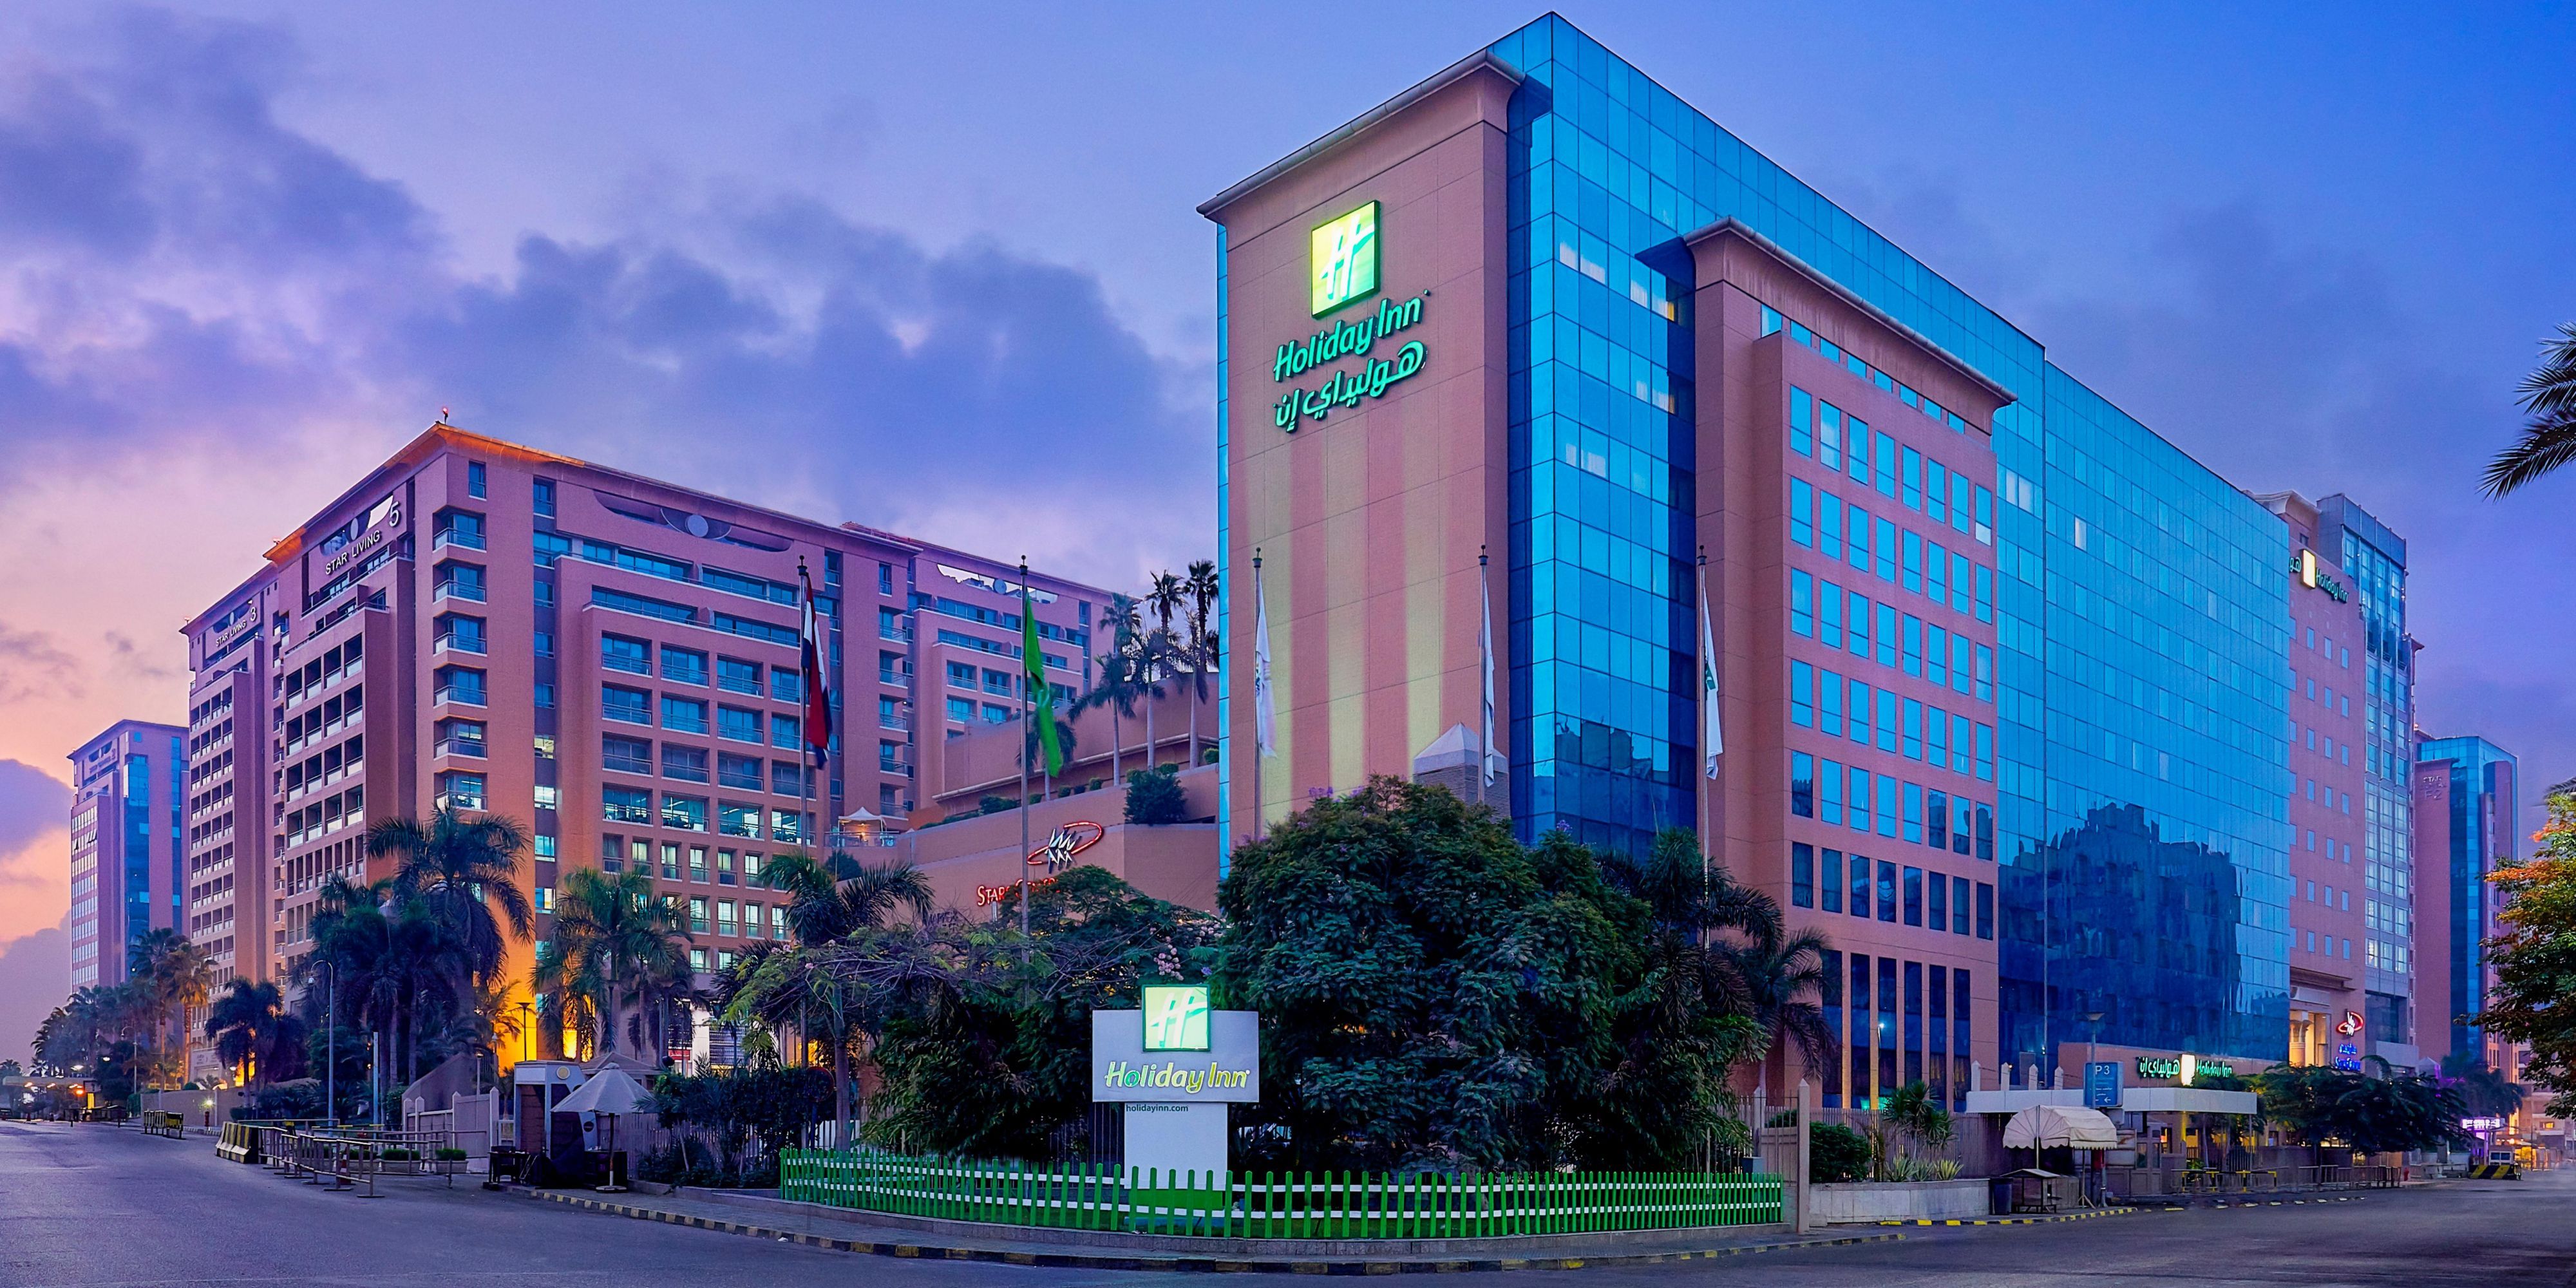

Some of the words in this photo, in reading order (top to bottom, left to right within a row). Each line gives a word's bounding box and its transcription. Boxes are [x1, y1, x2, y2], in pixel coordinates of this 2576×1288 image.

[1273, 319, 1377, 382] Holiday
[1377, 298, 1423, 338] Inn
[1302, 341, 1427, 420] هوليداي
[1274, 388, 1303, 433] إن
[389, 501, 399, 527] 5
[325, 552, 348, 575] STAR
[352, 530, 381, 558] LIVING
[2316, 568, 2338, 600] Holiday
[2339, 582, 2349, 602] Inn
[250, 607, 256, 622] 3
[216, 632, 229, 647] STAR
[230, 620, 247, 637] LIVING
[1104, 1061, 1204, 1094] Holiday
[1208, 1062, 1247, 1088] Inn
[2148, 1058, 2180, 1079] هوليداي
[2222, 1061, 2232, 1077] Inn
[1126, 1103, 1189, 1113] holidayinn.com
